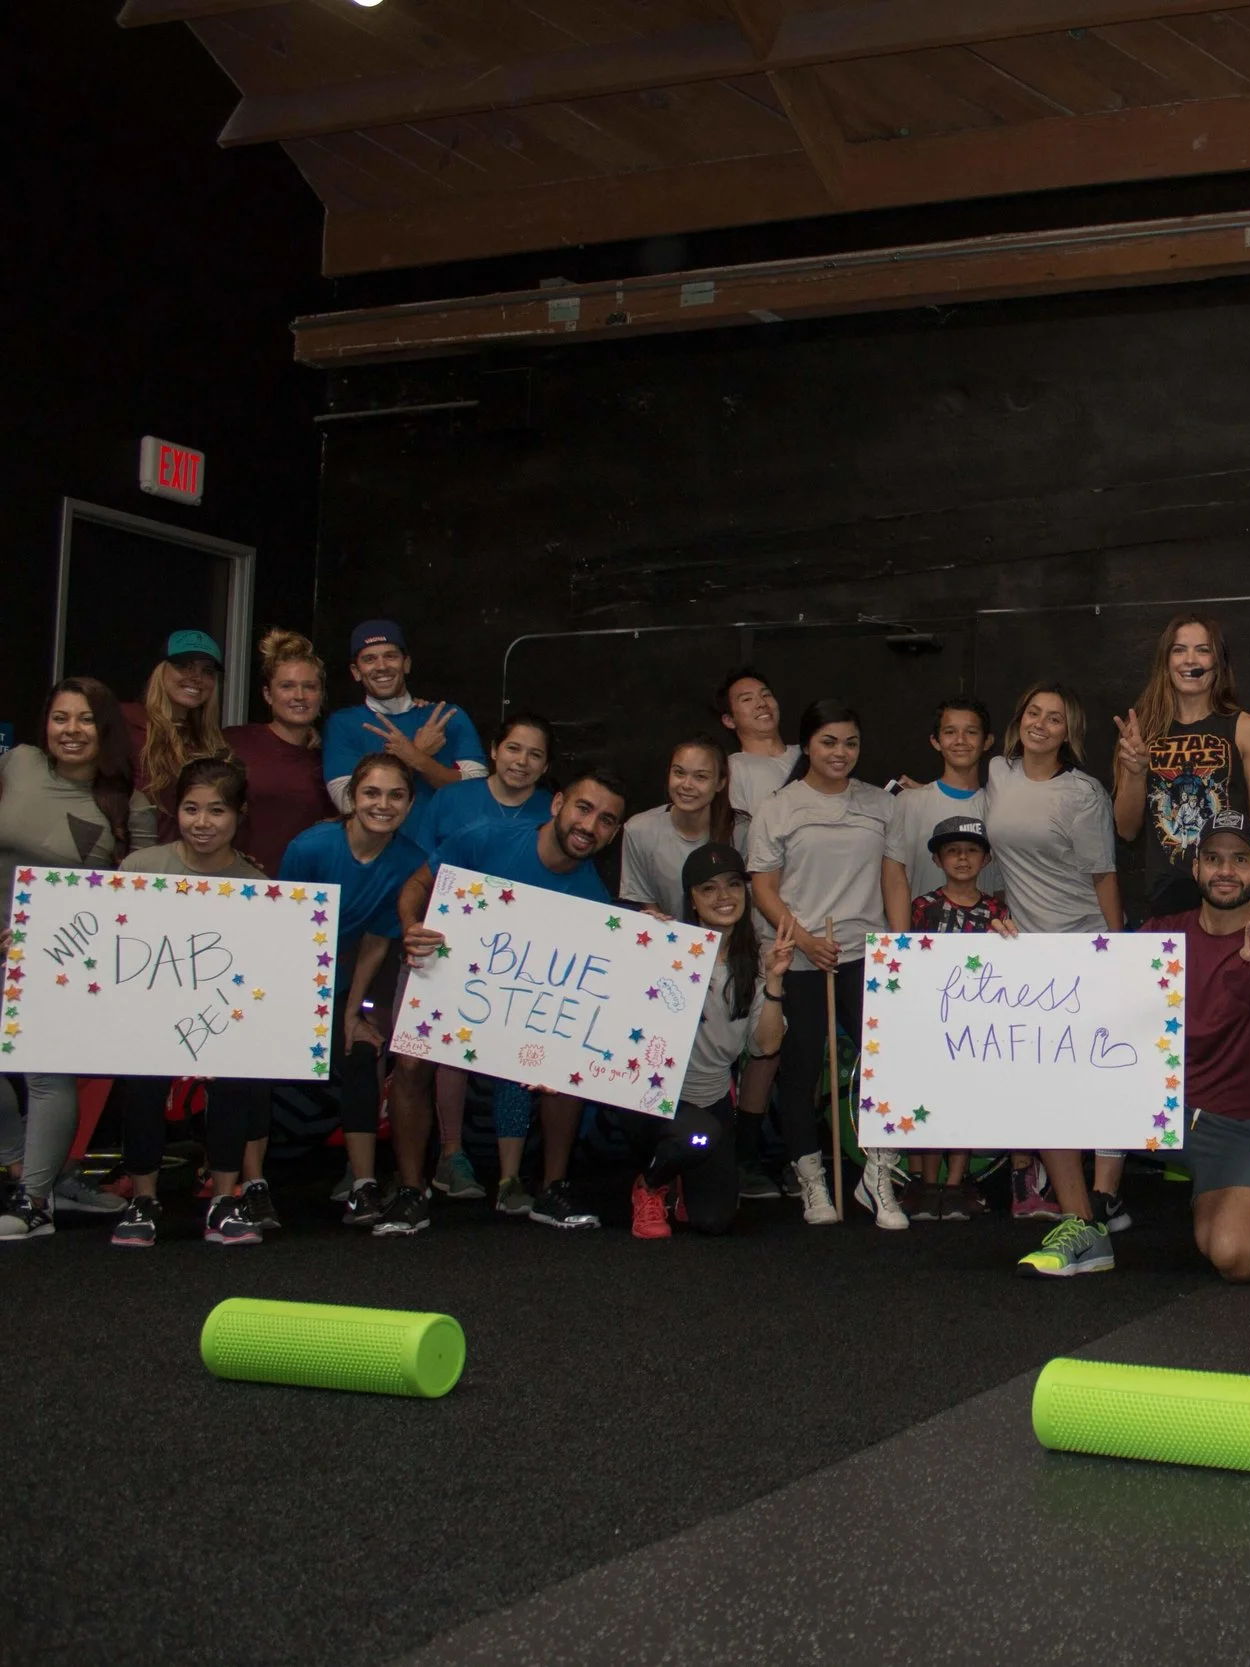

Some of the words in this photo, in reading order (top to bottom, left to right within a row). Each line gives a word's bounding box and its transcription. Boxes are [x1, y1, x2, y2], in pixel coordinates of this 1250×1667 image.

[160, 445, 201, 495] EXIT
[1149, 735, 1224, 752] STAR
[1150, 751, 1225, 769] WARS
[959, 822, 983, 835] NIKE
[43, 911, 99, 966] WHO
[116, 931, 233, 990] DAB
[480, 932, 611, 1000] BLUE
[458, 979, 604, 1053] STEEL
[936, 962, 1081, 1023] fitness
[945, 1024, 1076, 1064] MAFIA
